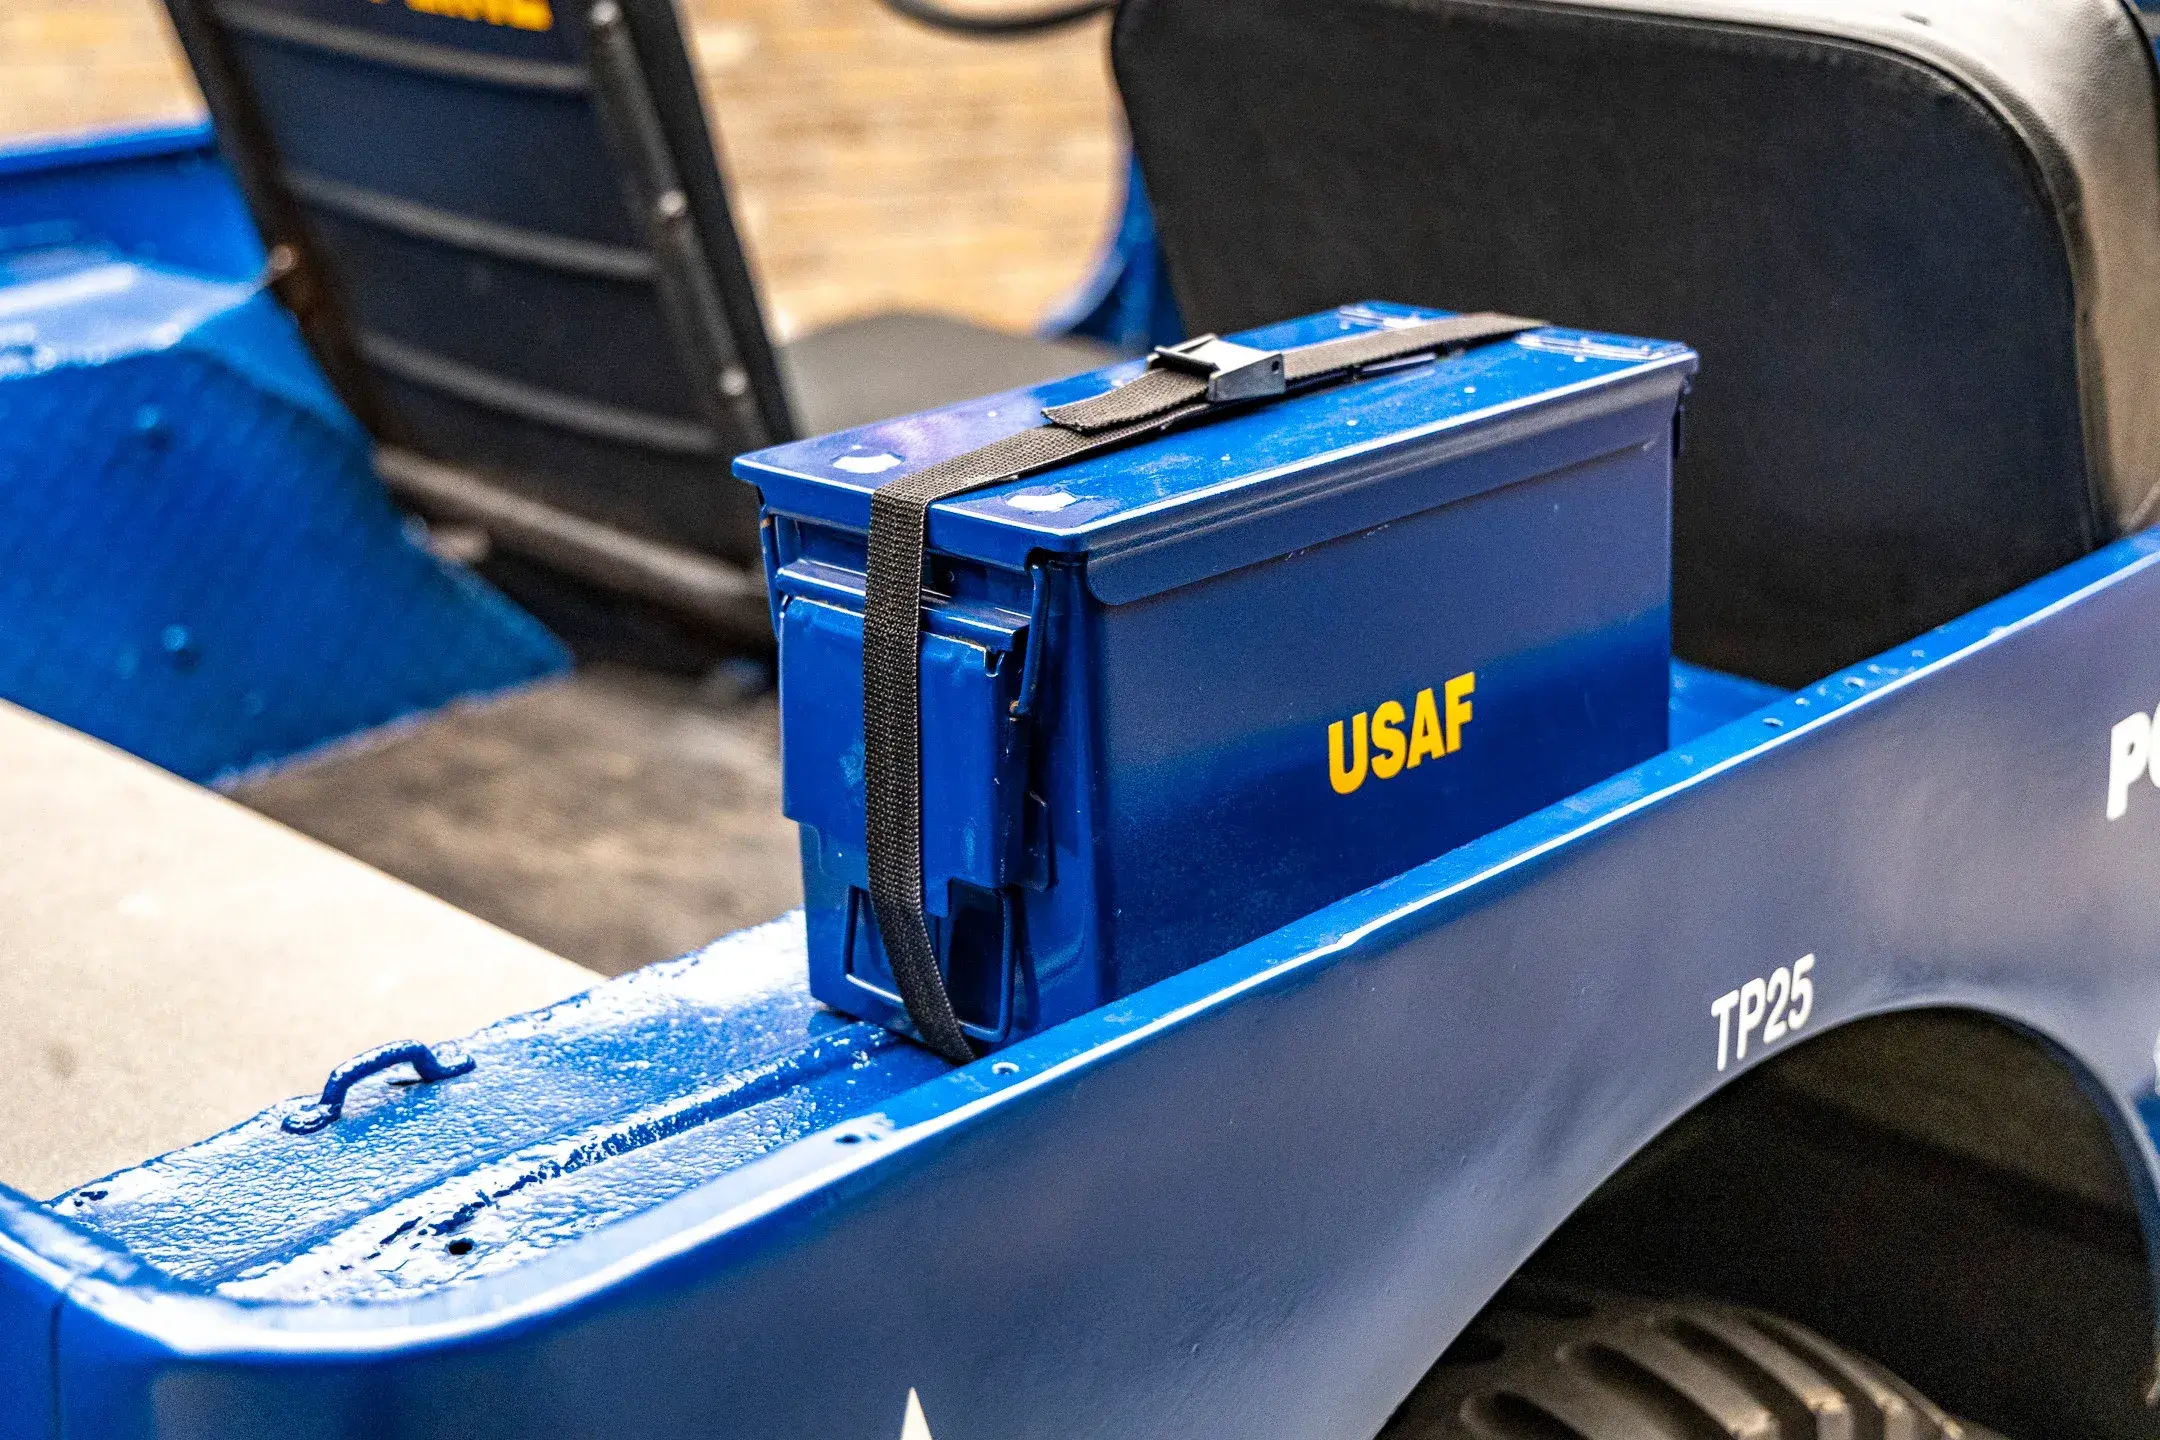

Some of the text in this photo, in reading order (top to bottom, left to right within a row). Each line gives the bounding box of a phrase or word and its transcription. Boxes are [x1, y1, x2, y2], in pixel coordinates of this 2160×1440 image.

[1327, 671, 1476, 795] USAF
[2106, 699, 2160, 821] P
[1711, 952, 1816, 1072] TP25
